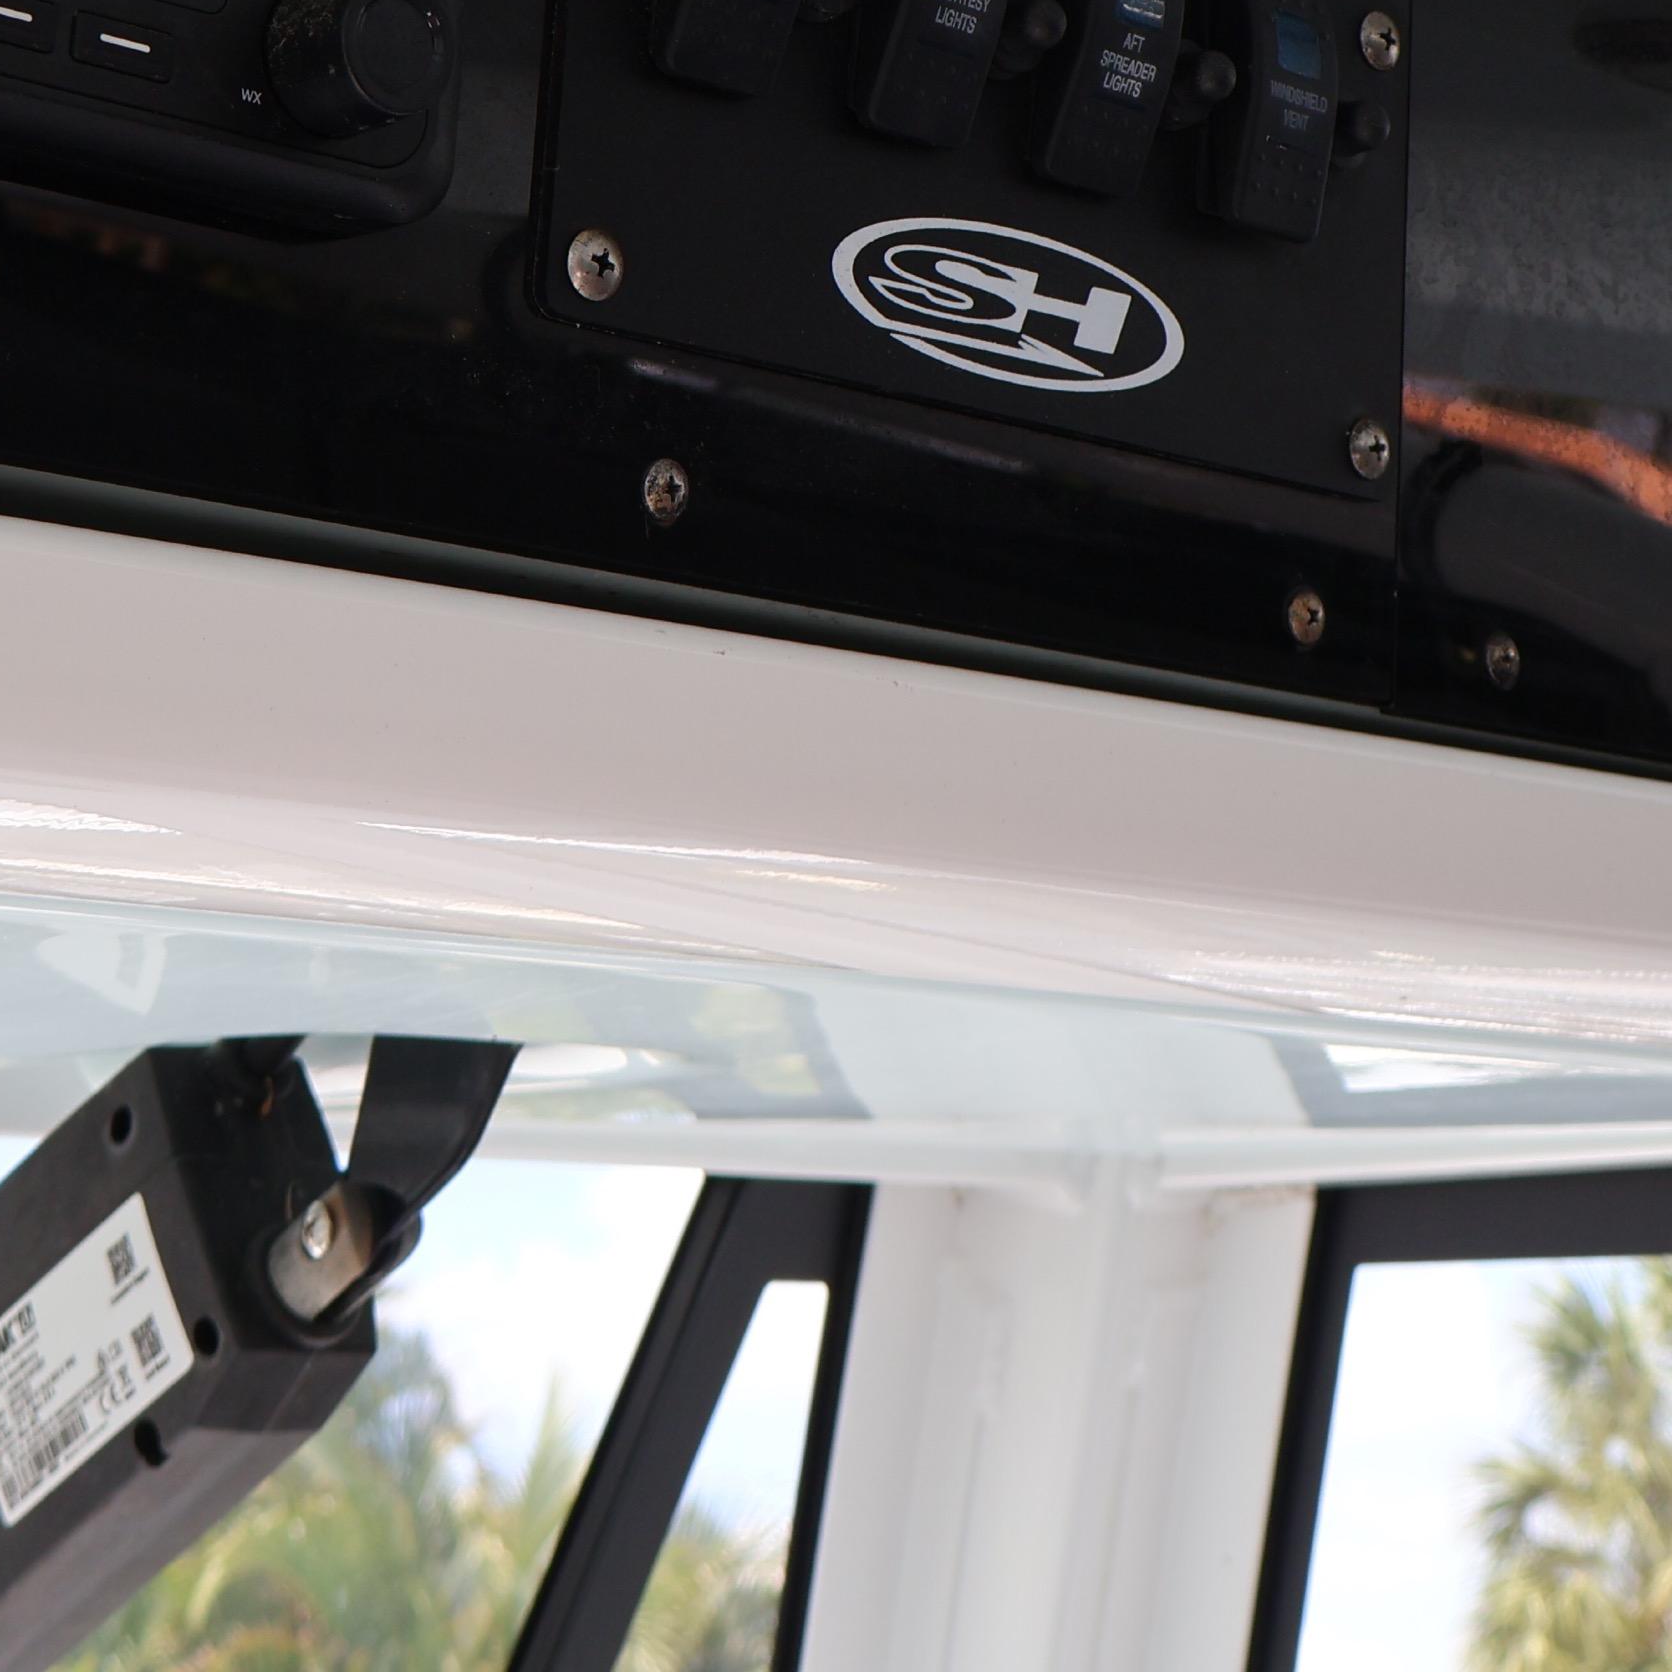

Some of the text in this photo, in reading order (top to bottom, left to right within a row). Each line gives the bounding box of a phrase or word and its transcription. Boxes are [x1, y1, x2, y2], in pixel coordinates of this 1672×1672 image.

[934, 5, 978, 35] LIGHTS
[1122, 32, 1146, 54] AFT
[1100, 49, 1157, 84] SPREADER
[240, 87, 263, 106] WX
[1102, 71, 1143, 99] LIGHTS
[1270, 79, 1328, 114] WINDSHIELD
[1282, 108, 1311, 131] VENT
